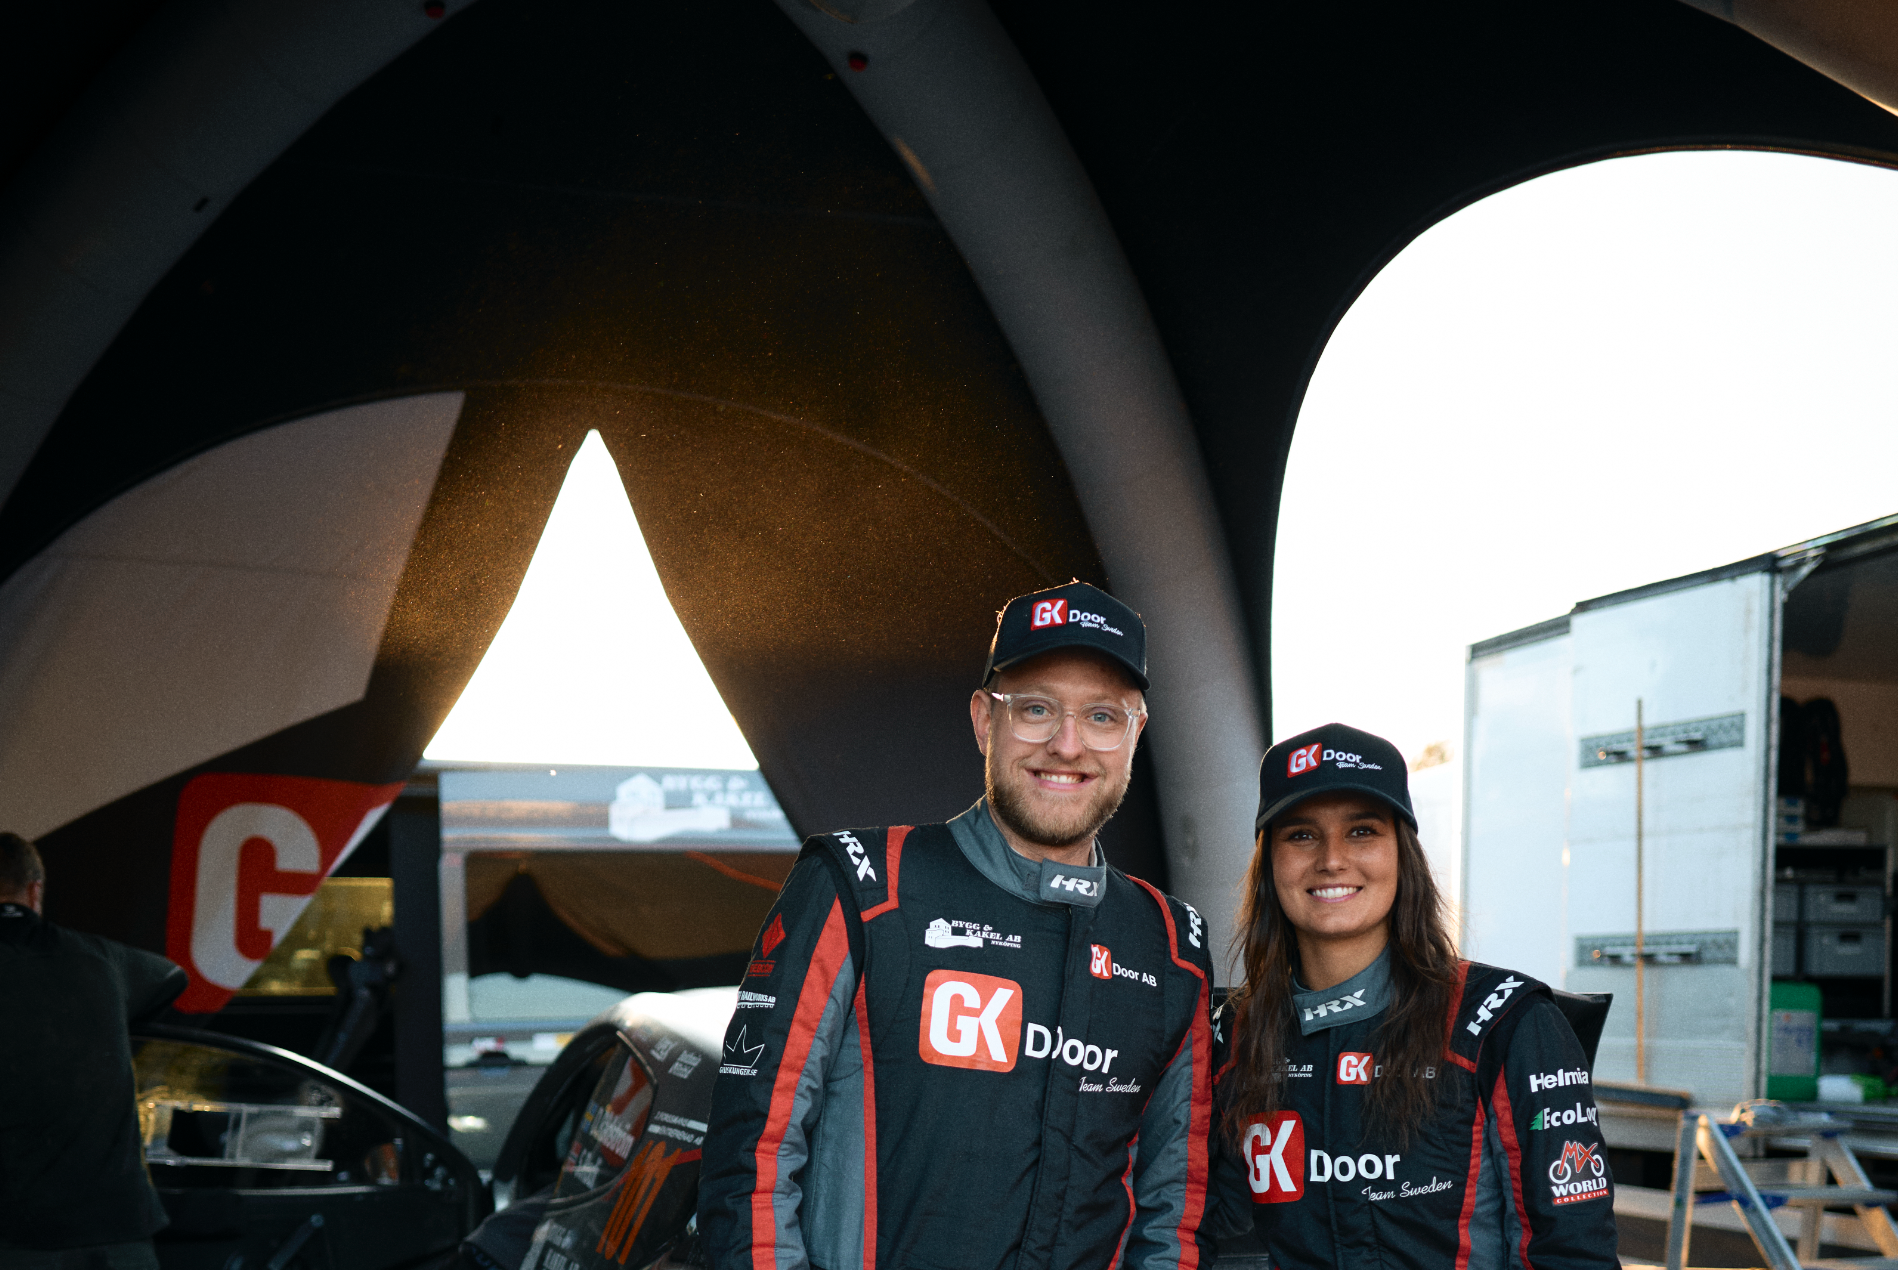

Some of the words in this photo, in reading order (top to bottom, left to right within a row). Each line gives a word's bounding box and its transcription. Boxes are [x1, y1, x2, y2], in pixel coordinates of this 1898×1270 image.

[1033, 600, 1065, 626] GK
[1069, 609, 1106, 624] Door
[1289, 744, 1319, 773] GK
[1322, 749, 1362, 763] Door
[832, 830, 877, 882] HRX
[951, 920, 981, 931] BYGG
[982, 924, 993, 932] &
[965, 929, 1003, 940] KAKEL
[1005, 934, 1022, 943] AB
[1090, 946, 1110, 976] GK
[1112, 962, 1140, 981] Door
[1141, 972, 1157, 987] AB
[1304, 988, 1367, 1021] HRX
[1466, 975, 1525, 1036] HRX
[929, 980, 1015, 1063] GK
[1024, 1022, 1119, 1074] Door
[1339, 1055, 1371, 1082] GK
[1529, 1067, 1590, 1093] Helmia
[1078, 1076, 1104, 1092] Team
[1105, 1077, 1141, 1093] Sweden
[1243, 1119, 1298, 1194] GK
[1309, 1149, 1401, 1183] Door
[1558, 1140, 1600, 1176] MX
[1361, 1186, 1396, 1201] Team
[1400, 1176, 1454, 1198] Sweden
[1551, 1176, 1608, 1198] WORLD
[1556, 1190, 1609, 1204] COLLECTION
